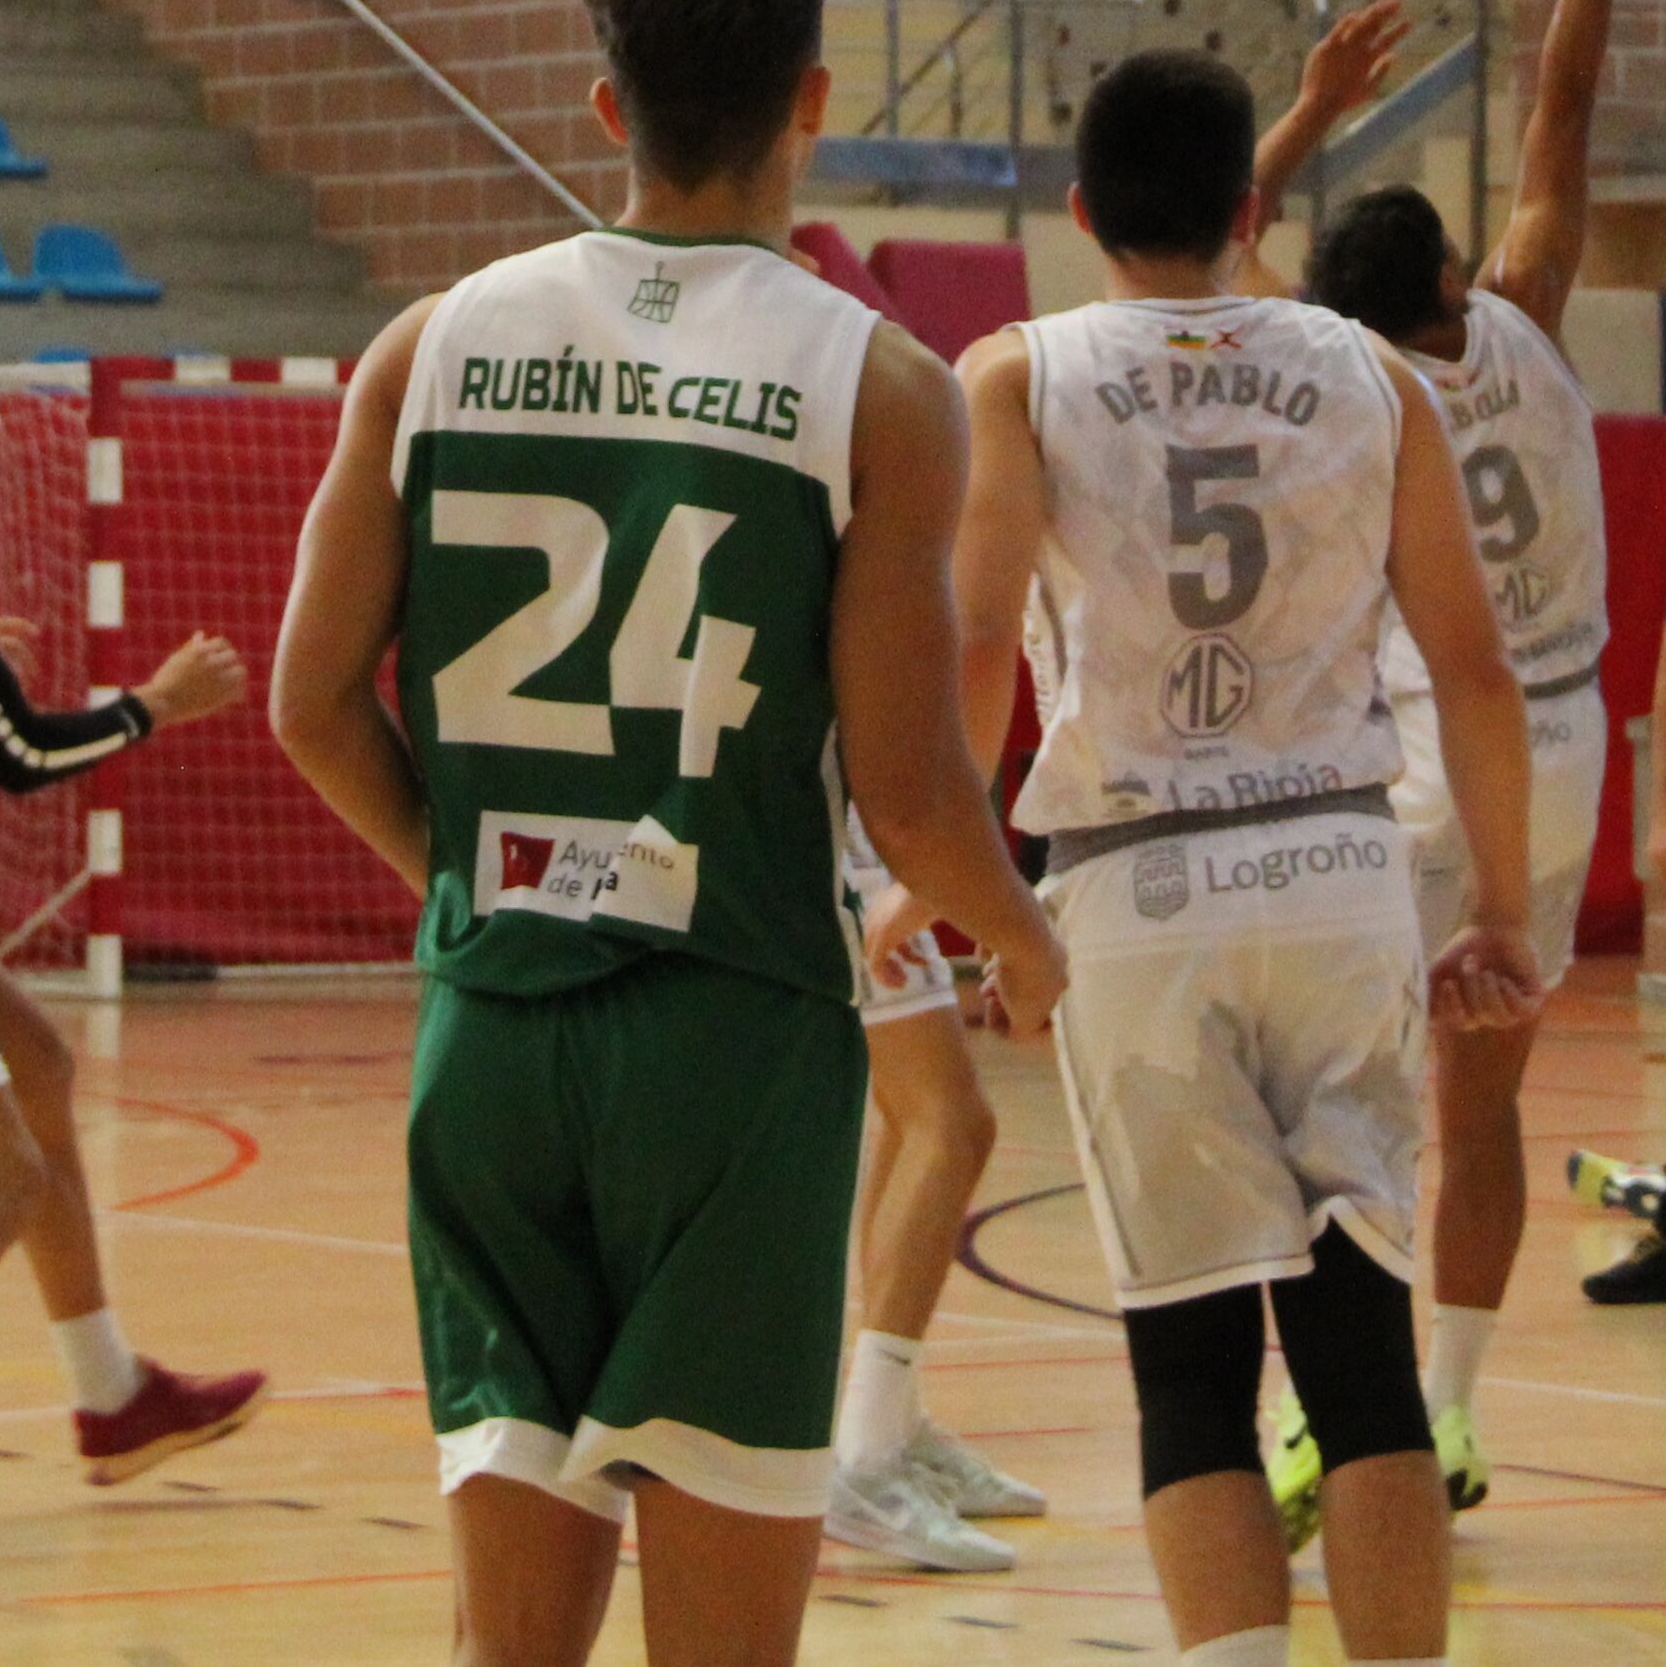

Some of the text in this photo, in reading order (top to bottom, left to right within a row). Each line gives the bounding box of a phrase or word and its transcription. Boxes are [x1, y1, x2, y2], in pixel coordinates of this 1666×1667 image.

[459, 346, 802, 442] RUBÍN DE CELIS
[1096, 361, 1321, 427] DE PABLO
[1164, 443, 1269, 631] 5
[1461, 444, 1540, 563] 9
[432, 489, 762, 778] 24
[1166, 641, 1248, 728] MG
[546, 871, 582, 897] de
[1205, 834, 1388, 893] Logroño
